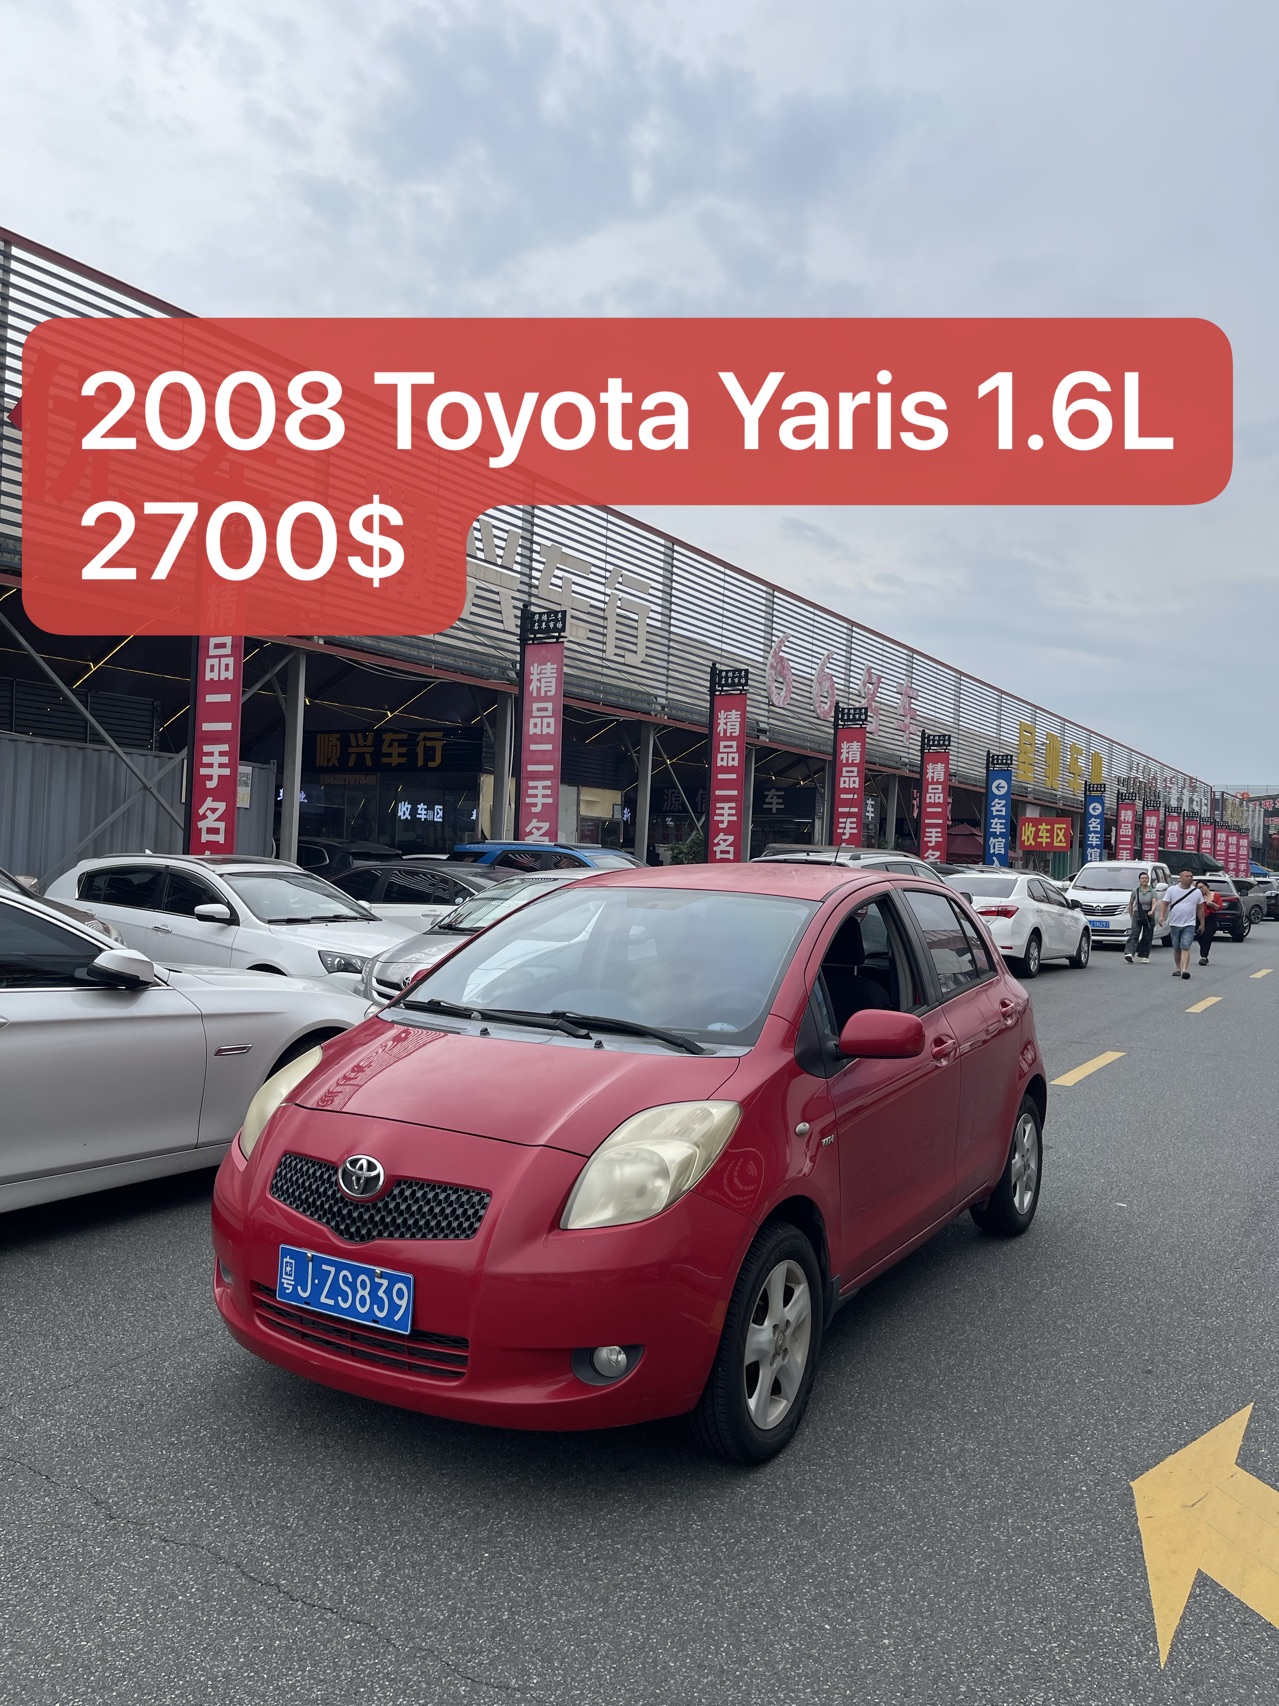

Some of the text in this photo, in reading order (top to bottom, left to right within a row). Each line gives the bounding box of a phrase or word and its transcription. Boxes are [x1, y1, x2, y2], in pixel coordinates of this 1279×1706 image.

[316, 732, 444, 768] 顺兴车行
[713, 710, 741, 859] 精品二手名
[837, 741, 861, 847] 精品二手
[398, 802, 443, 822] 收车区
[1022, 823, 1066, 846] 收车区
[1087, 818, 1101, 861] 名车馆
[281, 1256, 409, 1322] 粤J·ZS839
